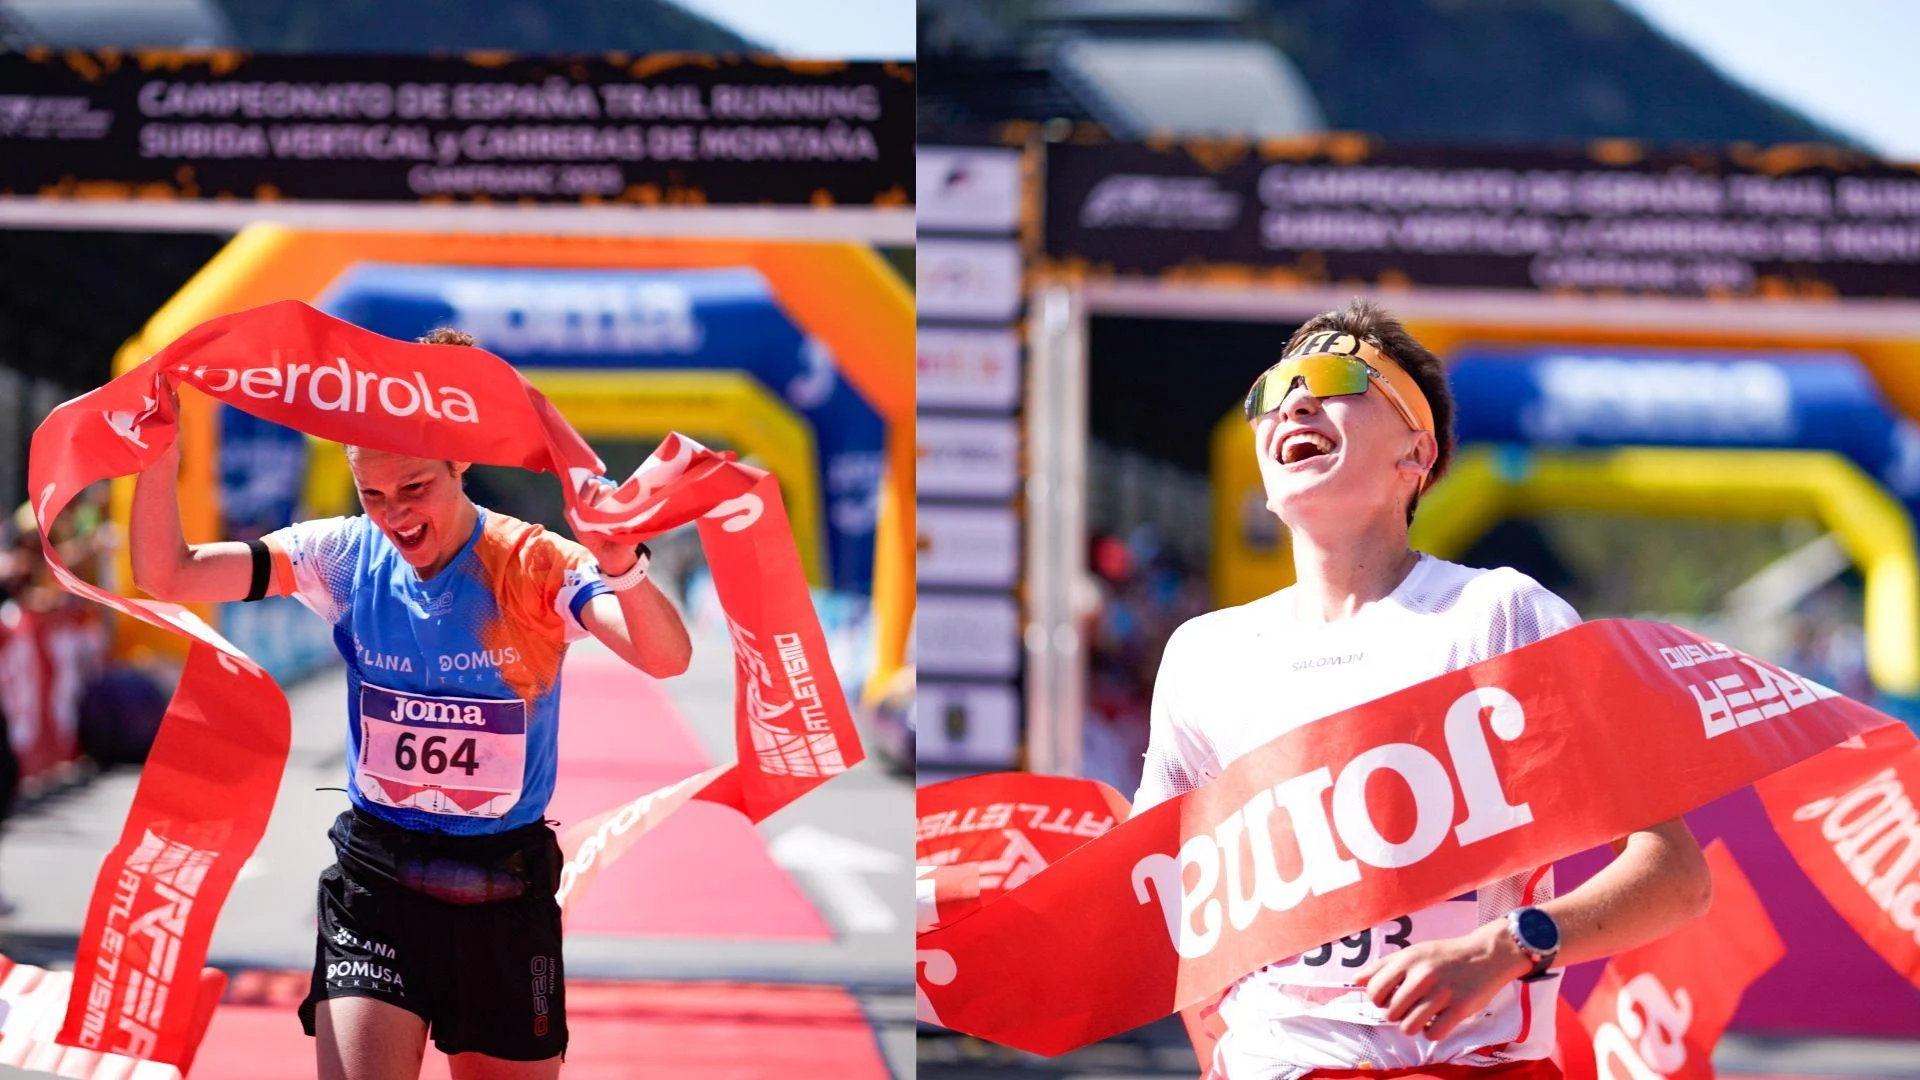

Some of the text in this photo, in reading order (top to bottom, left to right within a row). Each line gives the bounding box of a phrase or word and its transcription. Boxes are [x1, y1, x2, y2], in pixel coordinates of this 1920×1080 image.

[139, 82, 394, 118] CAMPEONATO
[397, 83, 449, 118] DE
[452, 75, 599, 119] ESPAÑA
[601, 84, 708, 119] TRAIL
[710, 85, 880, 120] RUNNING
[140, 122, 268, 157] SUBIDA
[269, 124, 432, 159] VERTICAL
[461, 125, 645, 160] CARRERAS
[647, 126, 699, 160] DE
[701, 119, 878, 161] MONTAÑA
[178, 357, 479, 424] berdrola
[773, 632, 830, 732] ATLETISMO
[1292, 652, 1364, 673] SALOMON
[390, 697, 486, 726] Joma
[395, 732, 480, 777] 664
[1131, 686, 1534, 959] Joma
[78, 869, 142, 1050] ATLETISMO
[326, 960, 405, 987] DOMUSA
